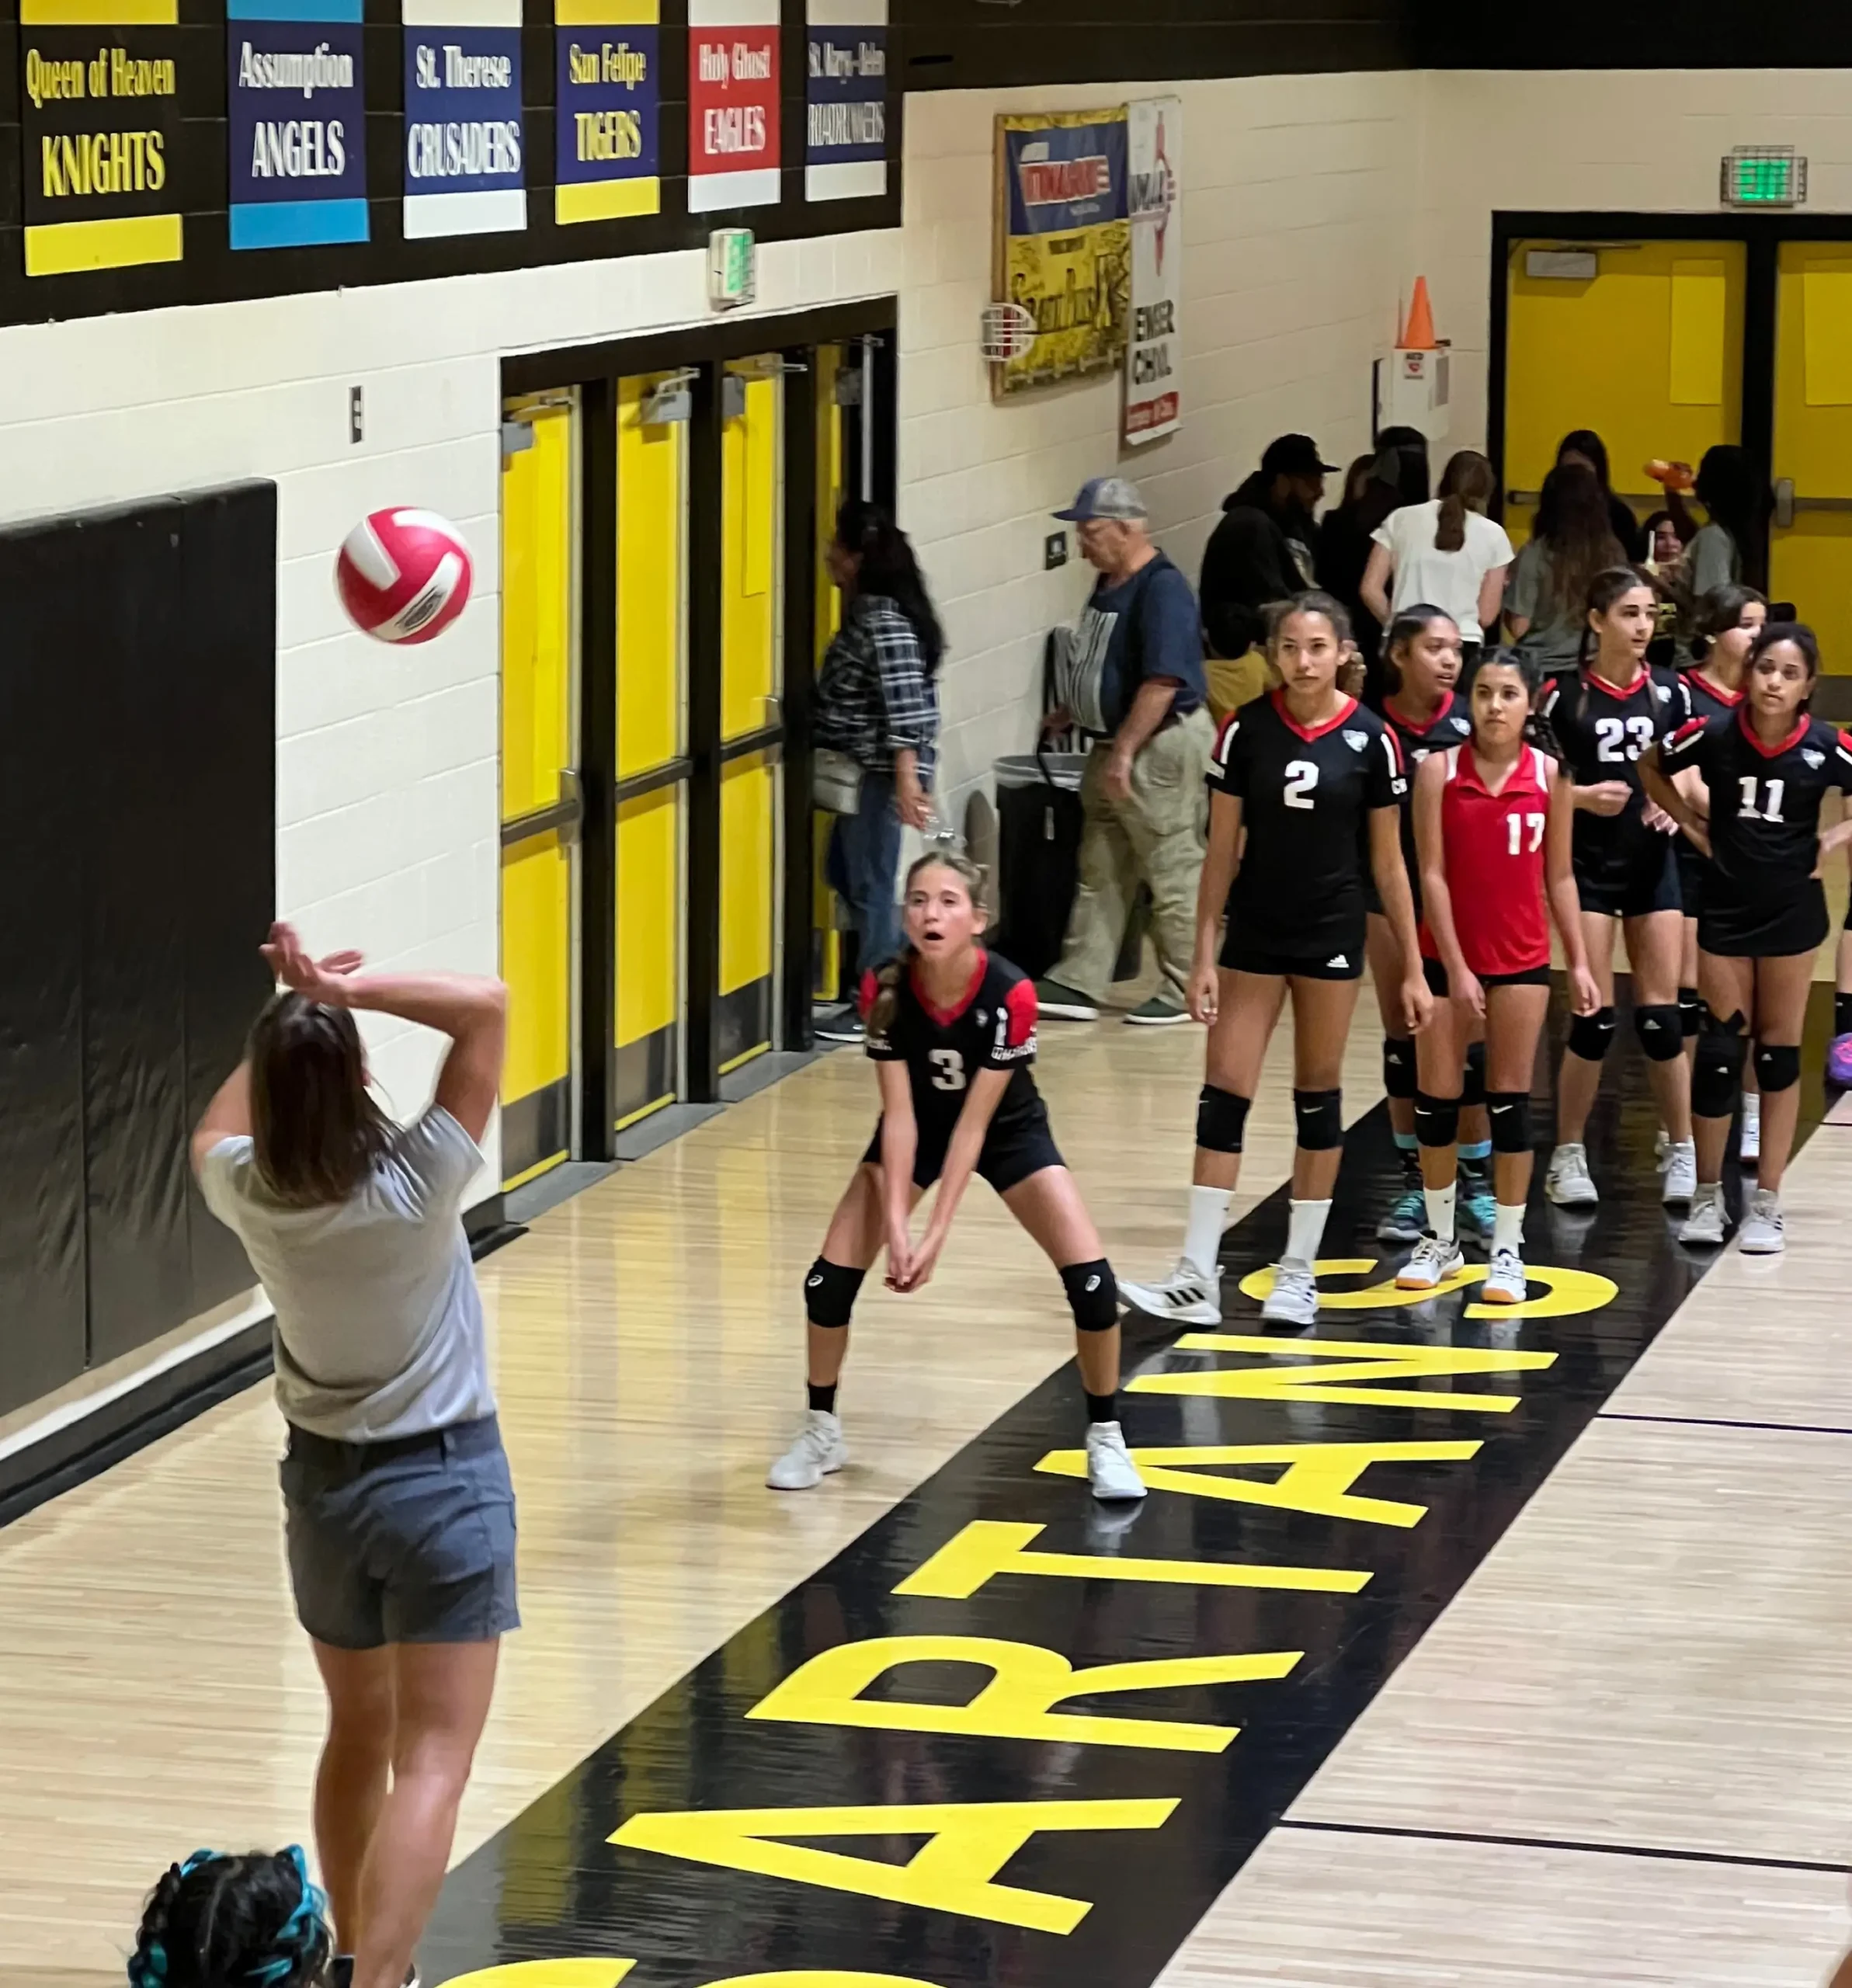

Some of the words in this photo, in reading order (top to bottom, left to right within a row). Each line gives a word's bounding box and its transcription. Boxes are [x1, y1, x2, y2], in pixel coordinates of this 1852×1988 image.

[26, 48, 84, 108] Queen
[89, 48, 108, 97] of
[111, 47, 175, 96] Heaven
[238, 41, 353, 99] Assumption
[415, 45, 441, 89] St.
[443, 44, 511, 89] Therese
[569, 43, 599, 84] San
[603, 43, 646, 90] Felipe
[699, 43, 728, 89] Holy
[732, 43, 770, 80] Ghost
[252, 120, 345, 178] ANGELS
[407, 120, 521, 178] CRUSADERS
[575, 110, 641, 162] TIGERS
[704, 106, 765, 155] EAGLES
[41, 130, 165, 197] KNIGHTS
[1596, 716, 1655, 763] 23
[1284, 760, 1319, 809] 2
[1737, 777, 1784, 822] 11
[1506, 812, 1545, 854] 17
[929, 1048, 966, 1090] 3
[434, 1259, 1619, 1988] ARTANS
